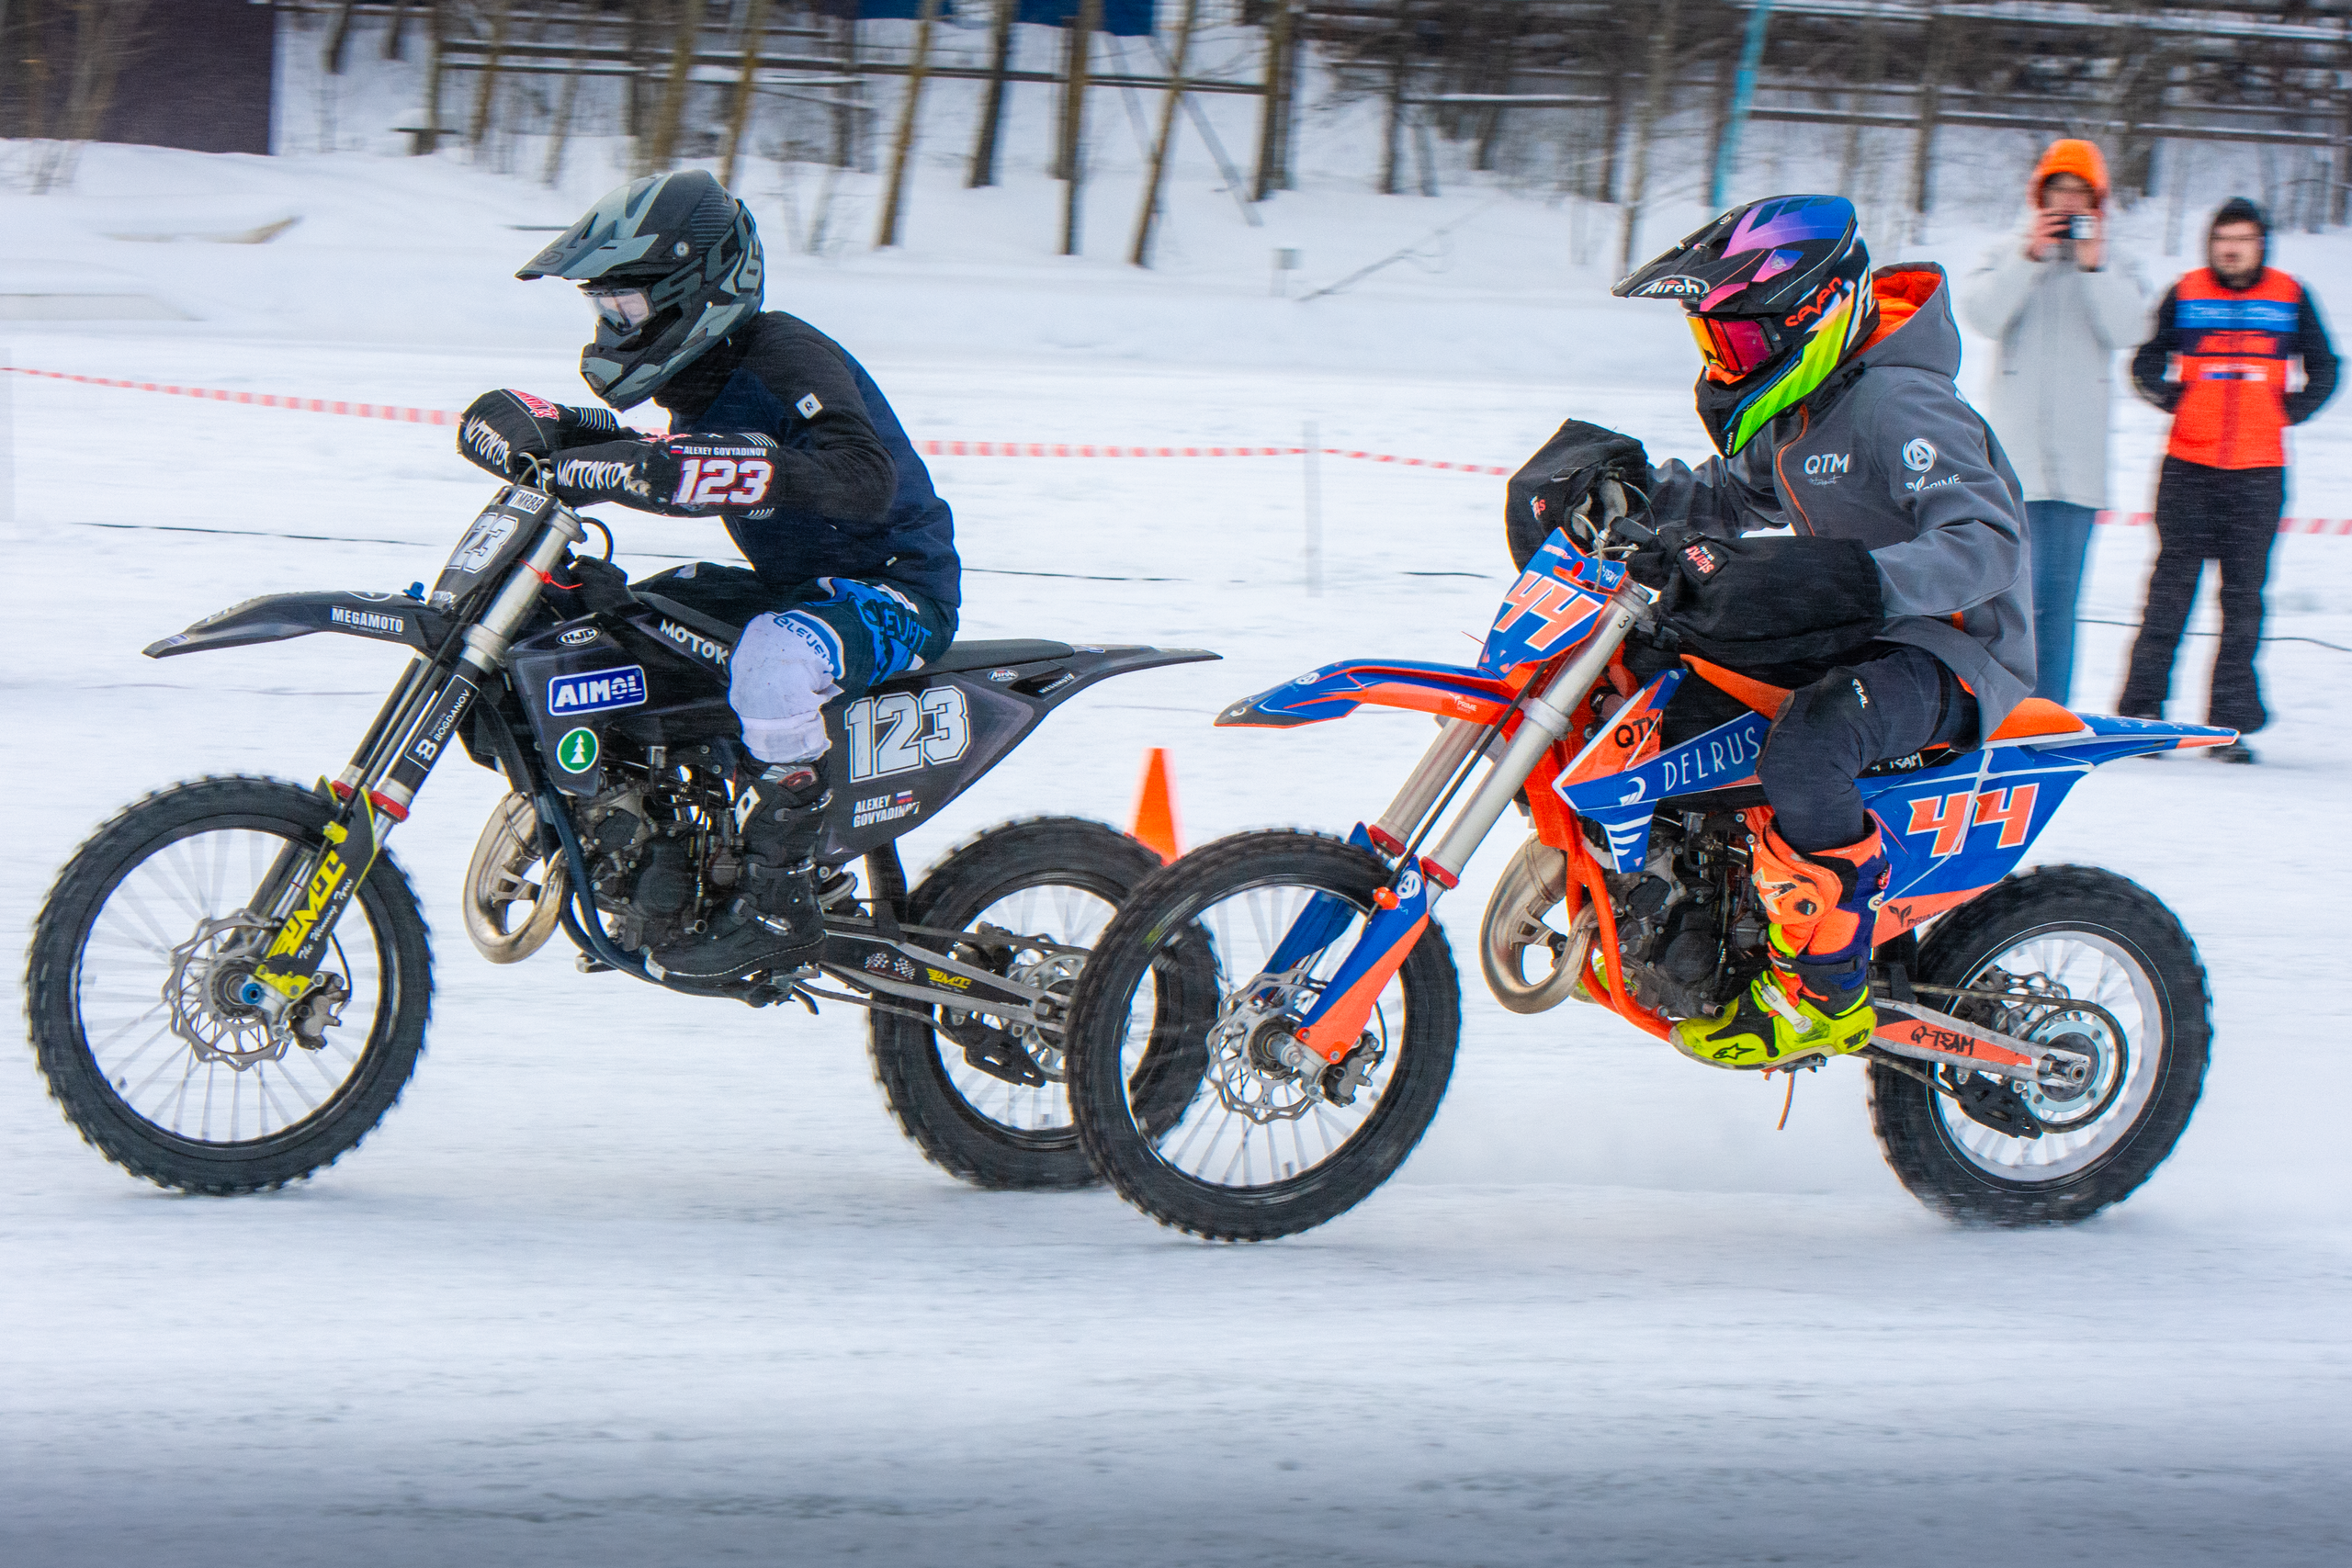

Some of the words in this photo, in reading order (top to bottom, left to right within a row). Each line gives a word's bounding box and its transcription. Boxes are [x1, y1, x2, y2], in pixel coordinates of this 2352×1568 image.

[1638, 279, 1701, 297] Airoh
[1804, 453, 1850, 475] QTM
[671, 457, 775, 506] 123
[512, 491, 545, 512] TMR88
[331, 607, 404, 633] MEGAMOTO
[1492, 570, 1605, 652] 44
[1617, 615, 1631, 630] 3
[562, 627, 598, 643] HJC
[553, 673, 643, 708] AIMOL
[433, 688, 471, 742] BOGDANOV
[843, 684, 971, 784] 123
[1662, 726, 1761, 793] DELRUS
[853, 794, 891, 814] ALEXEY
[1905, 782, 2041, 859] 44
[297, 943, 314, 959] The
[1910, 1025, 1975, 1056] Q-TEAM
